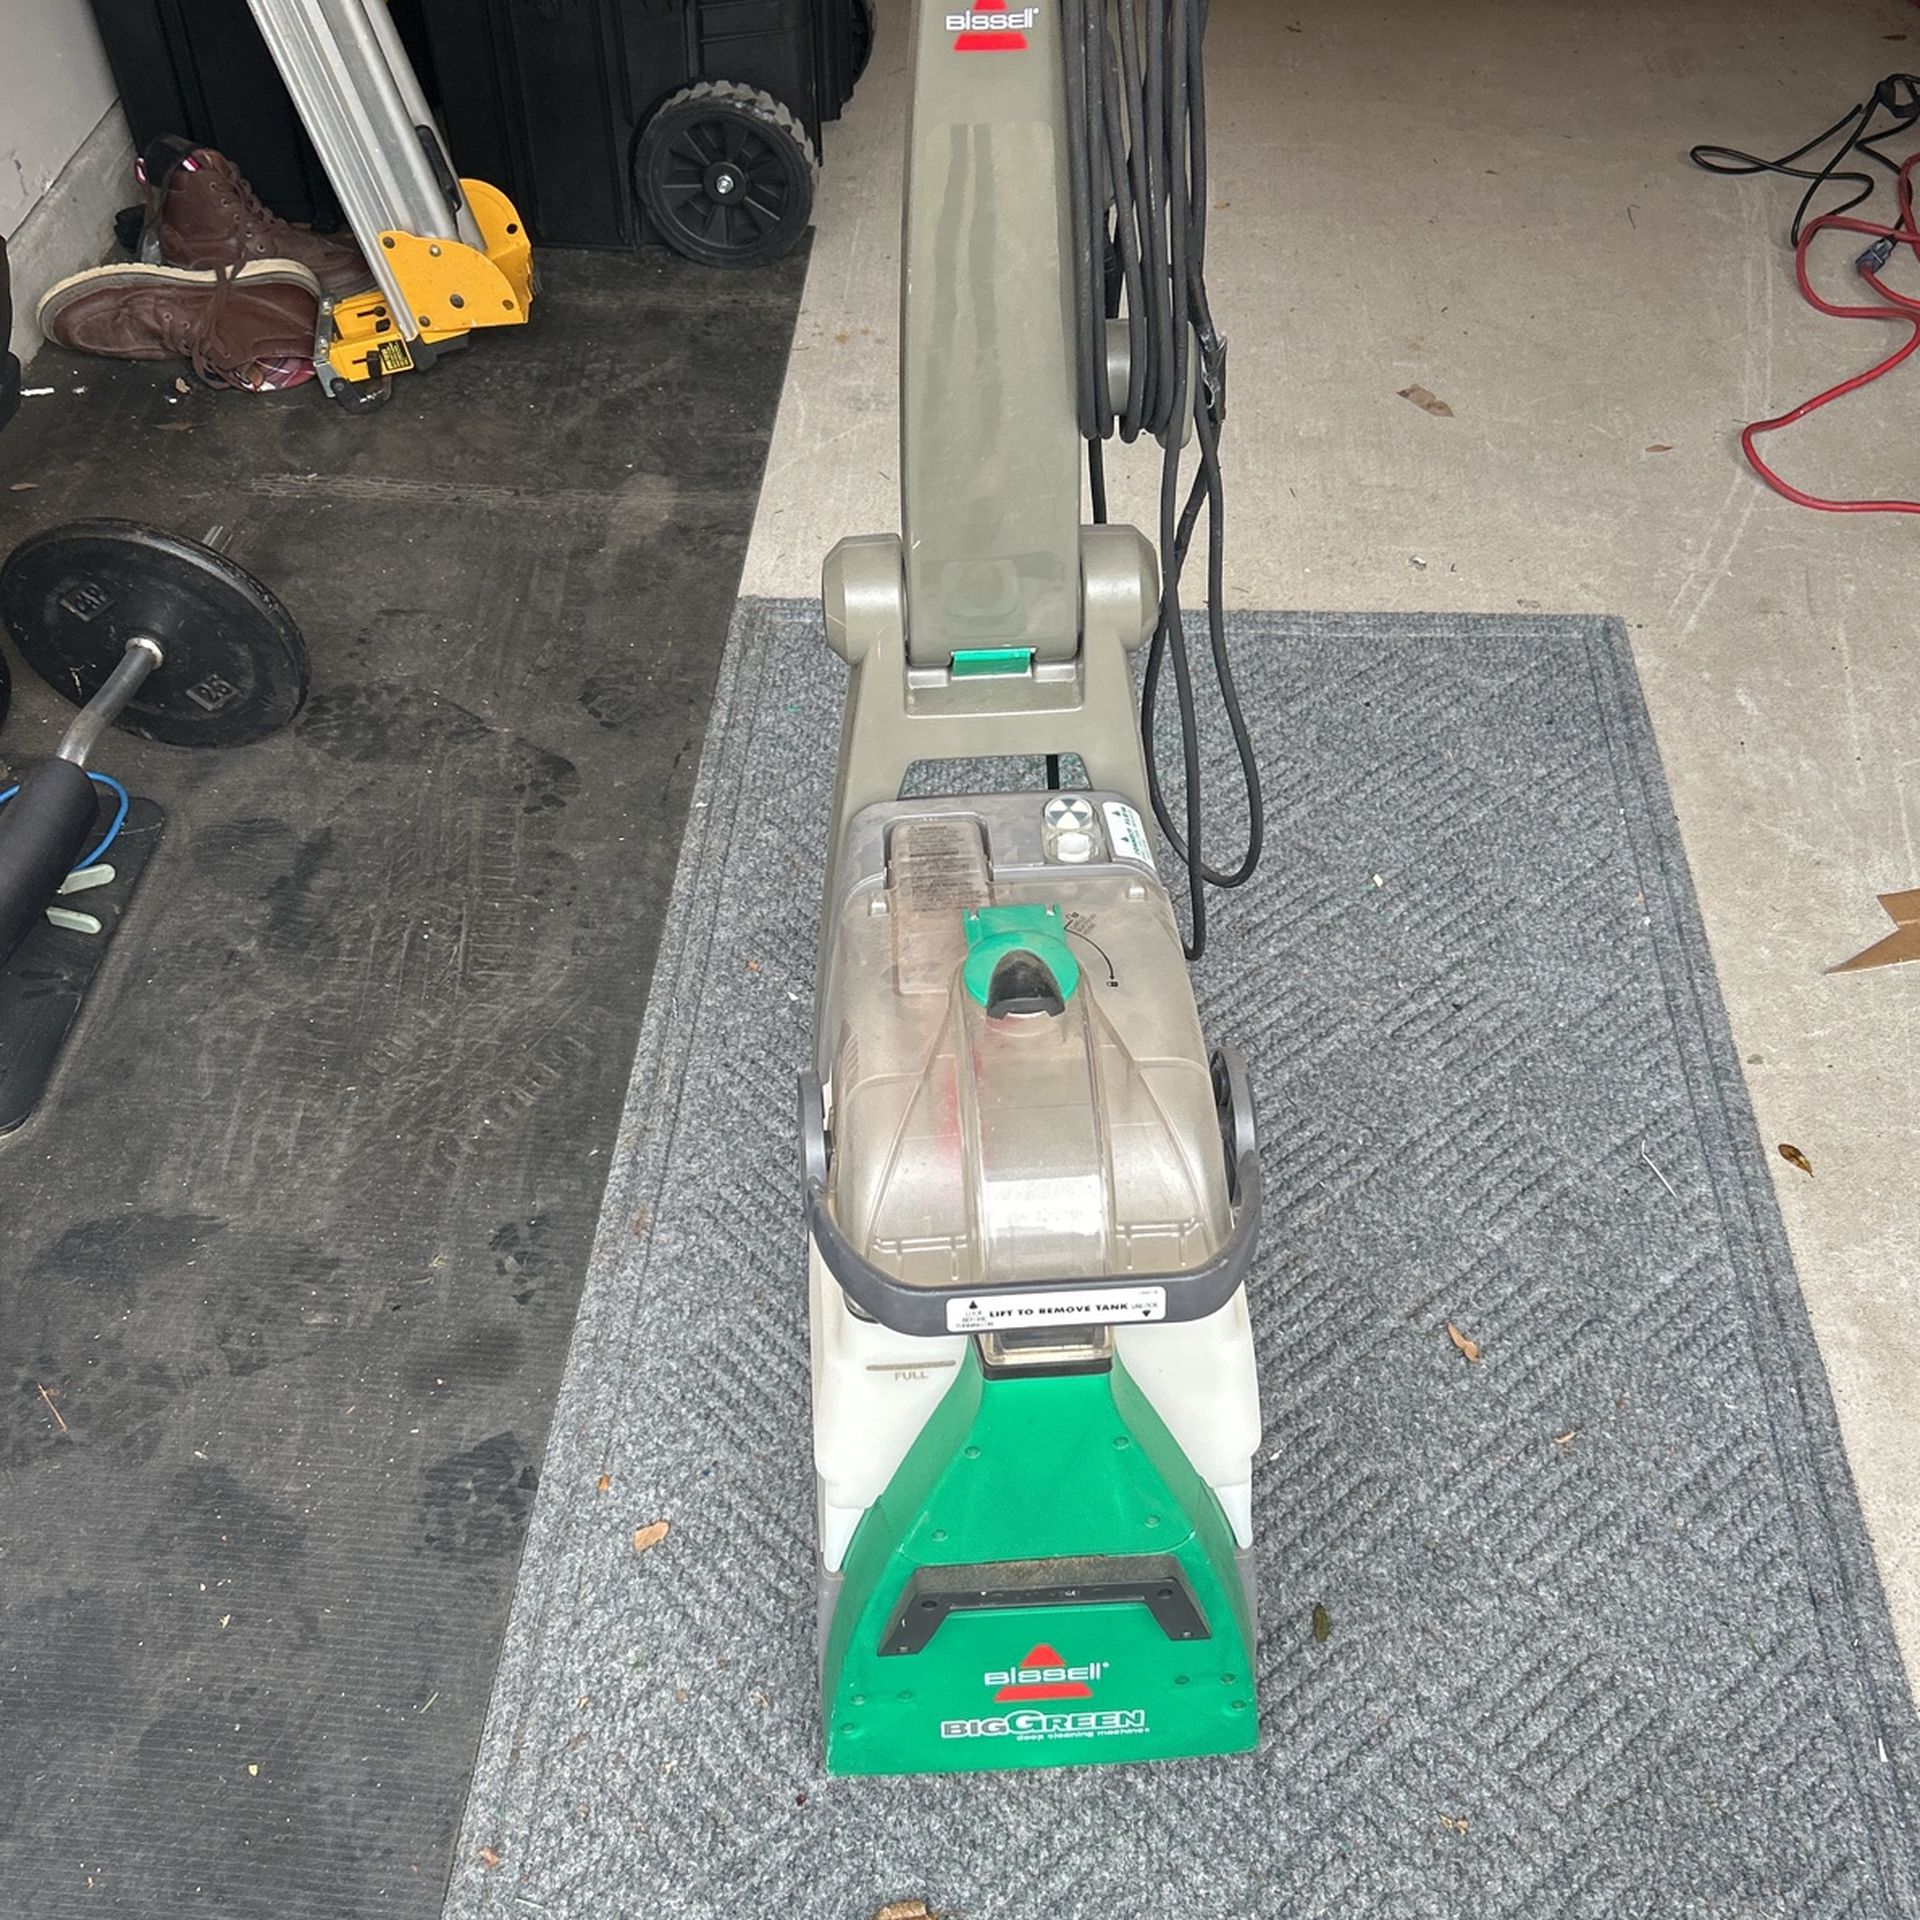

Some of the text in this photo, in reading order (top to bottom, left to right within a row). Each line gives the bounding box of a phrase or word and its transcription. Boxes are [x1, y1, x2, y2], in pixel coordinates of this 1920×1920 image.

[989, 1309, 1013, 1318] LIFT
[1017, 1308, 1034, 1317] TO
[1038, 1304, 1091, 1316] REMOVE
[1095, 1302, 1129, 1312] TANK
[894, 1370, 929, 1381] FULL
[1016, 1727, 1144, 1742] deep cleaning machine
